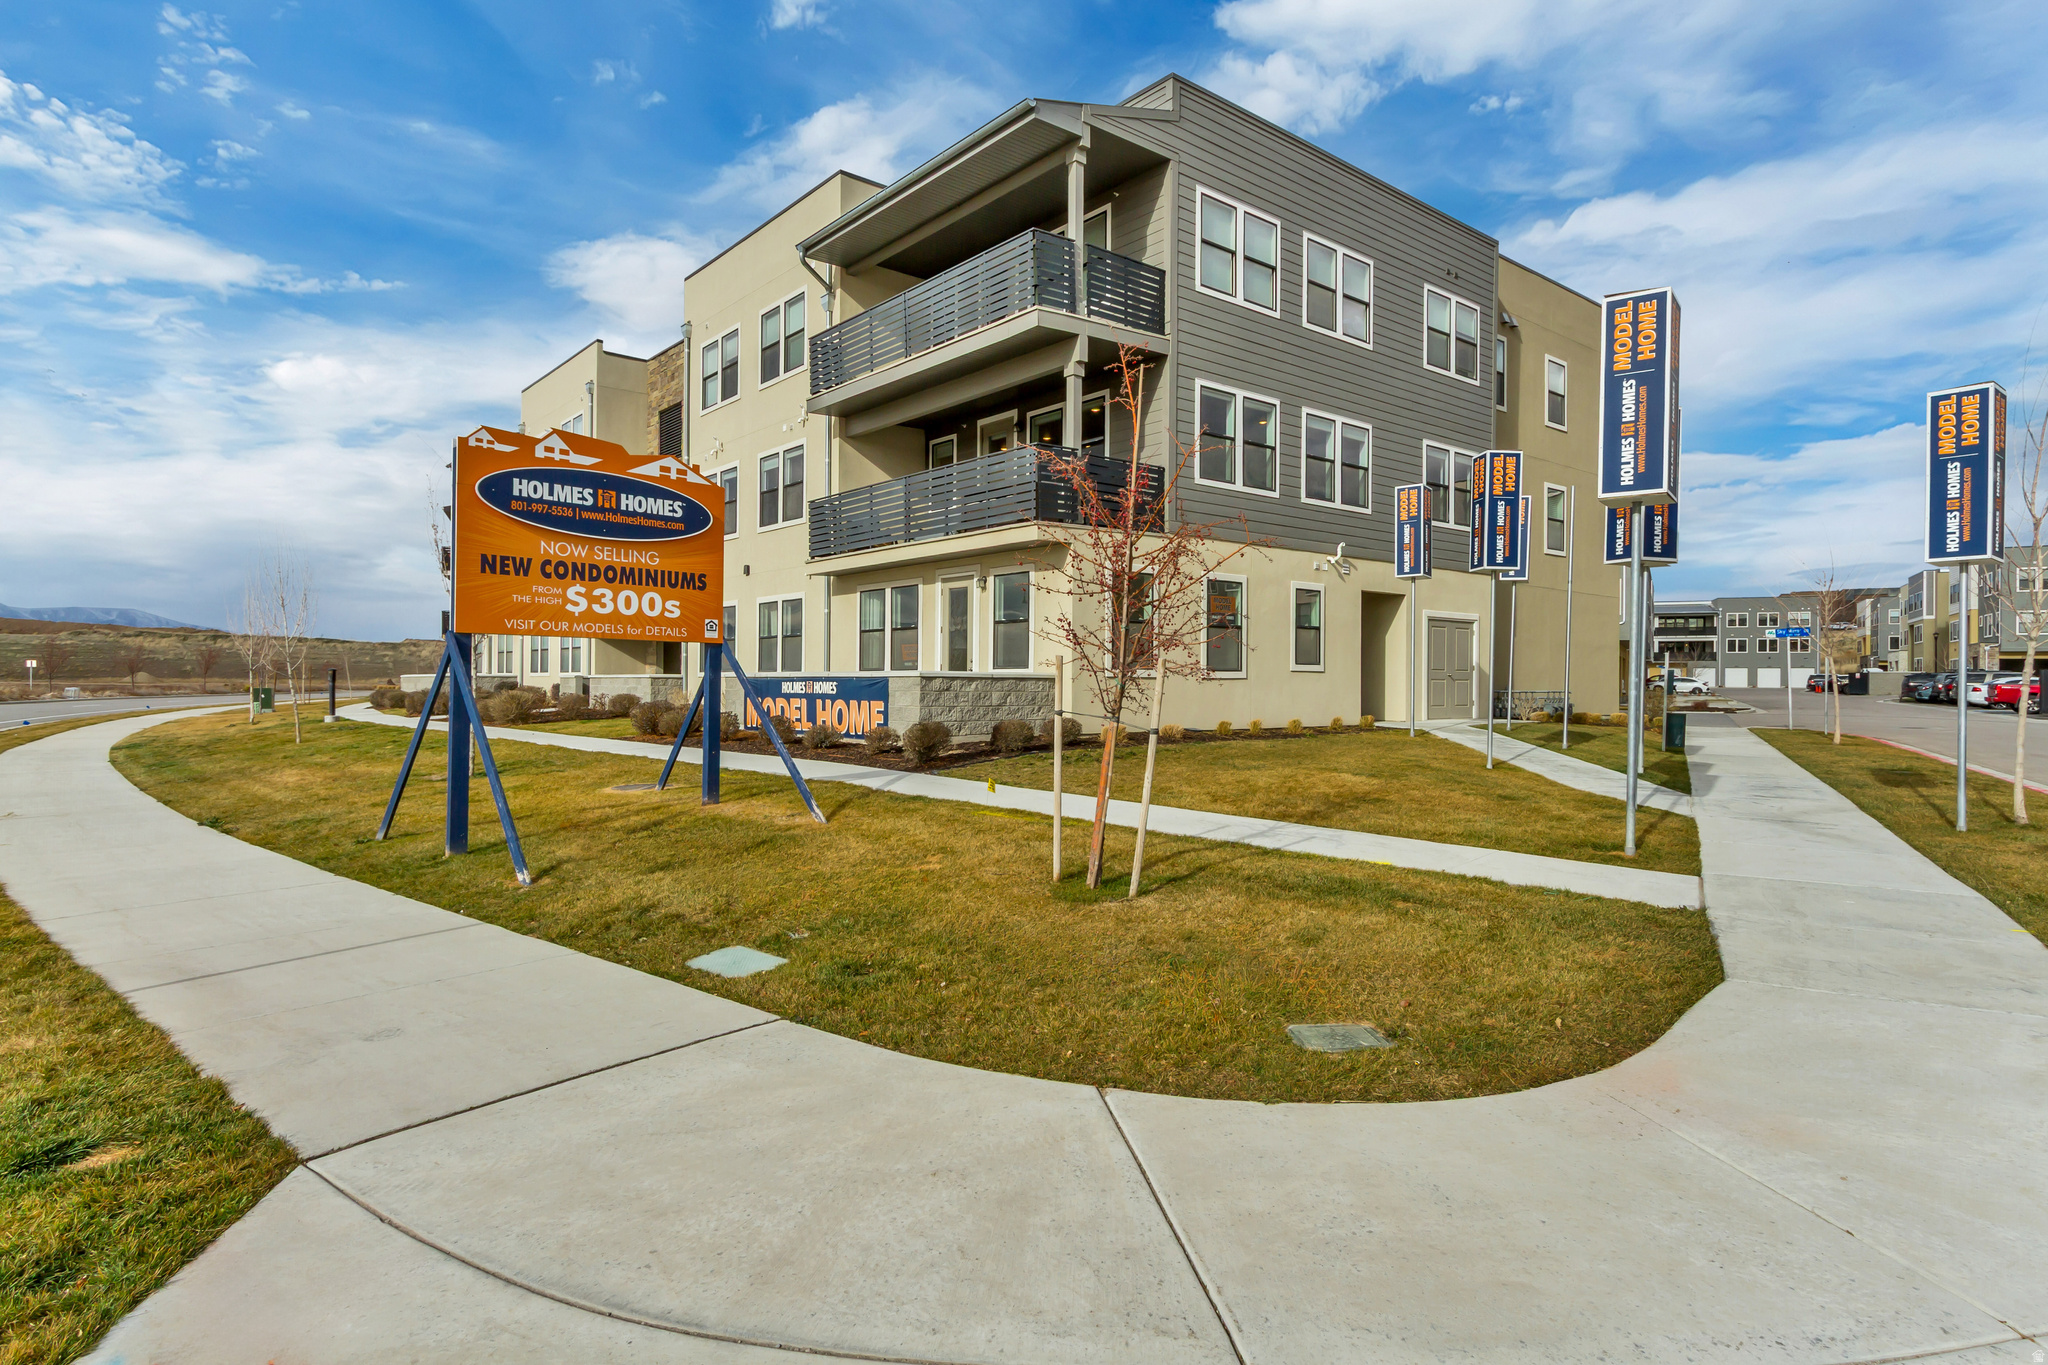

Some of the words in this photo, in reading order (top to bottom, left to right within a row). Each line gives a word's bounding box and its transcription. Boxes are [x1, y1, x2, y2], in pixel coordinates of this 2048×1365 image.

[1613, 300, 1633, 371] MODEL
[1637, 299, 1658, 361] HOME
[1621, 379, 1637, 423] HOMES
[1637, 385, 1647, 474] www.HolmesHomes.com
[1938, 394, 1957, 455] MODEL
[1961, 393, 1980, 447] HOME
[1493, 454, 1504, 496] MODEL
[1505, 456, 1516, 492] HOME
[1620, 437, 1635, 486] HOLMES
[1947, 461, 1961, 498] HOMES
[510, 500, 573, 518] 801-997-5536
[581, 510, 685, 531] www.HolmesHomes.com
[512, 477, 594, 506] HOLMES
[620, 493, 683, 518] HOMES
[1400, 488, 1408, 521] MODEL
[1409, 488, 1418, 517] HOME
[1497, 500, 1506, 526] HOMES
[1961, 467, 1972, 542] www.HolmesHomes.com
[1496, 534, 1504, 563] HOLMES
[1615, 518, 1624, 555] HOLMES
[1653, 516, 1662, 553] HOLMES
[1946, 511, 1960, 553] HOLMES
[540, 540, 589, 558] NOW
[594, 546, 660, 566] SELLING
[480, 553, 532, 577] NEW
[540, 559, 708, 592] CONDOMINIUMS
[532, 585, 563, 595] FROM
[512, 594, 532, 604] THE
[535, 595, 563, 606] HIGH
[565, 583, 681, 619] $300s
[505, 618, 536, 630] VISIT
[539, 620, 569, 632] OUR
[573, 622, 624, 635] MODELS
[627, 624, 642, 635] for
[645, 625, 688, 638] DETAILS
[781, 681, 806, 694] HOLMES
[813, 681, 837, 694] HOMES
[746, 696, 812, 731] MODEL
